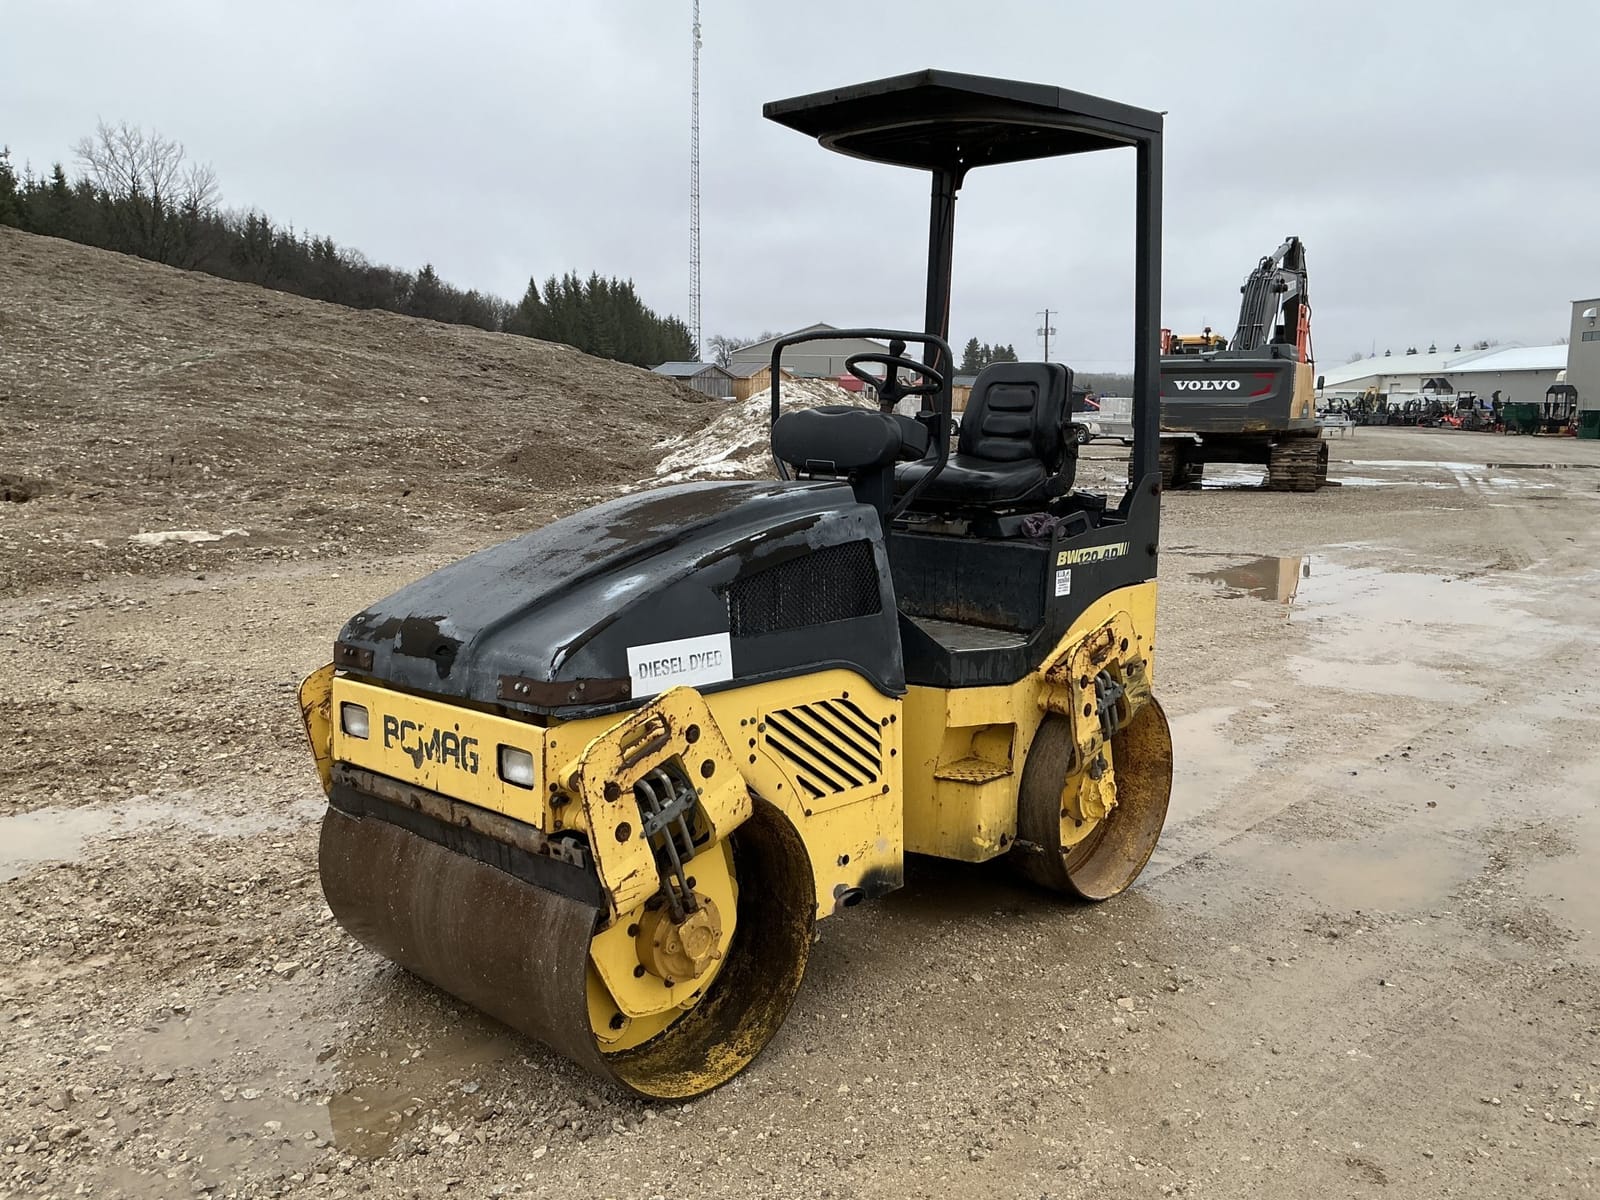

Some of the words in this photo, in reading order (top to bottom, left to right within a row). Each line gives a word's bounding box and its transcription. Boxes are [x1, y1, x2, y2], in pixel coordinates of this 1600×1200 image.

[1174, 380, 1240, 391] VOLVO
[639, 656, 687, 680] DIESEL
[689, 650, 722, 671] DYED
